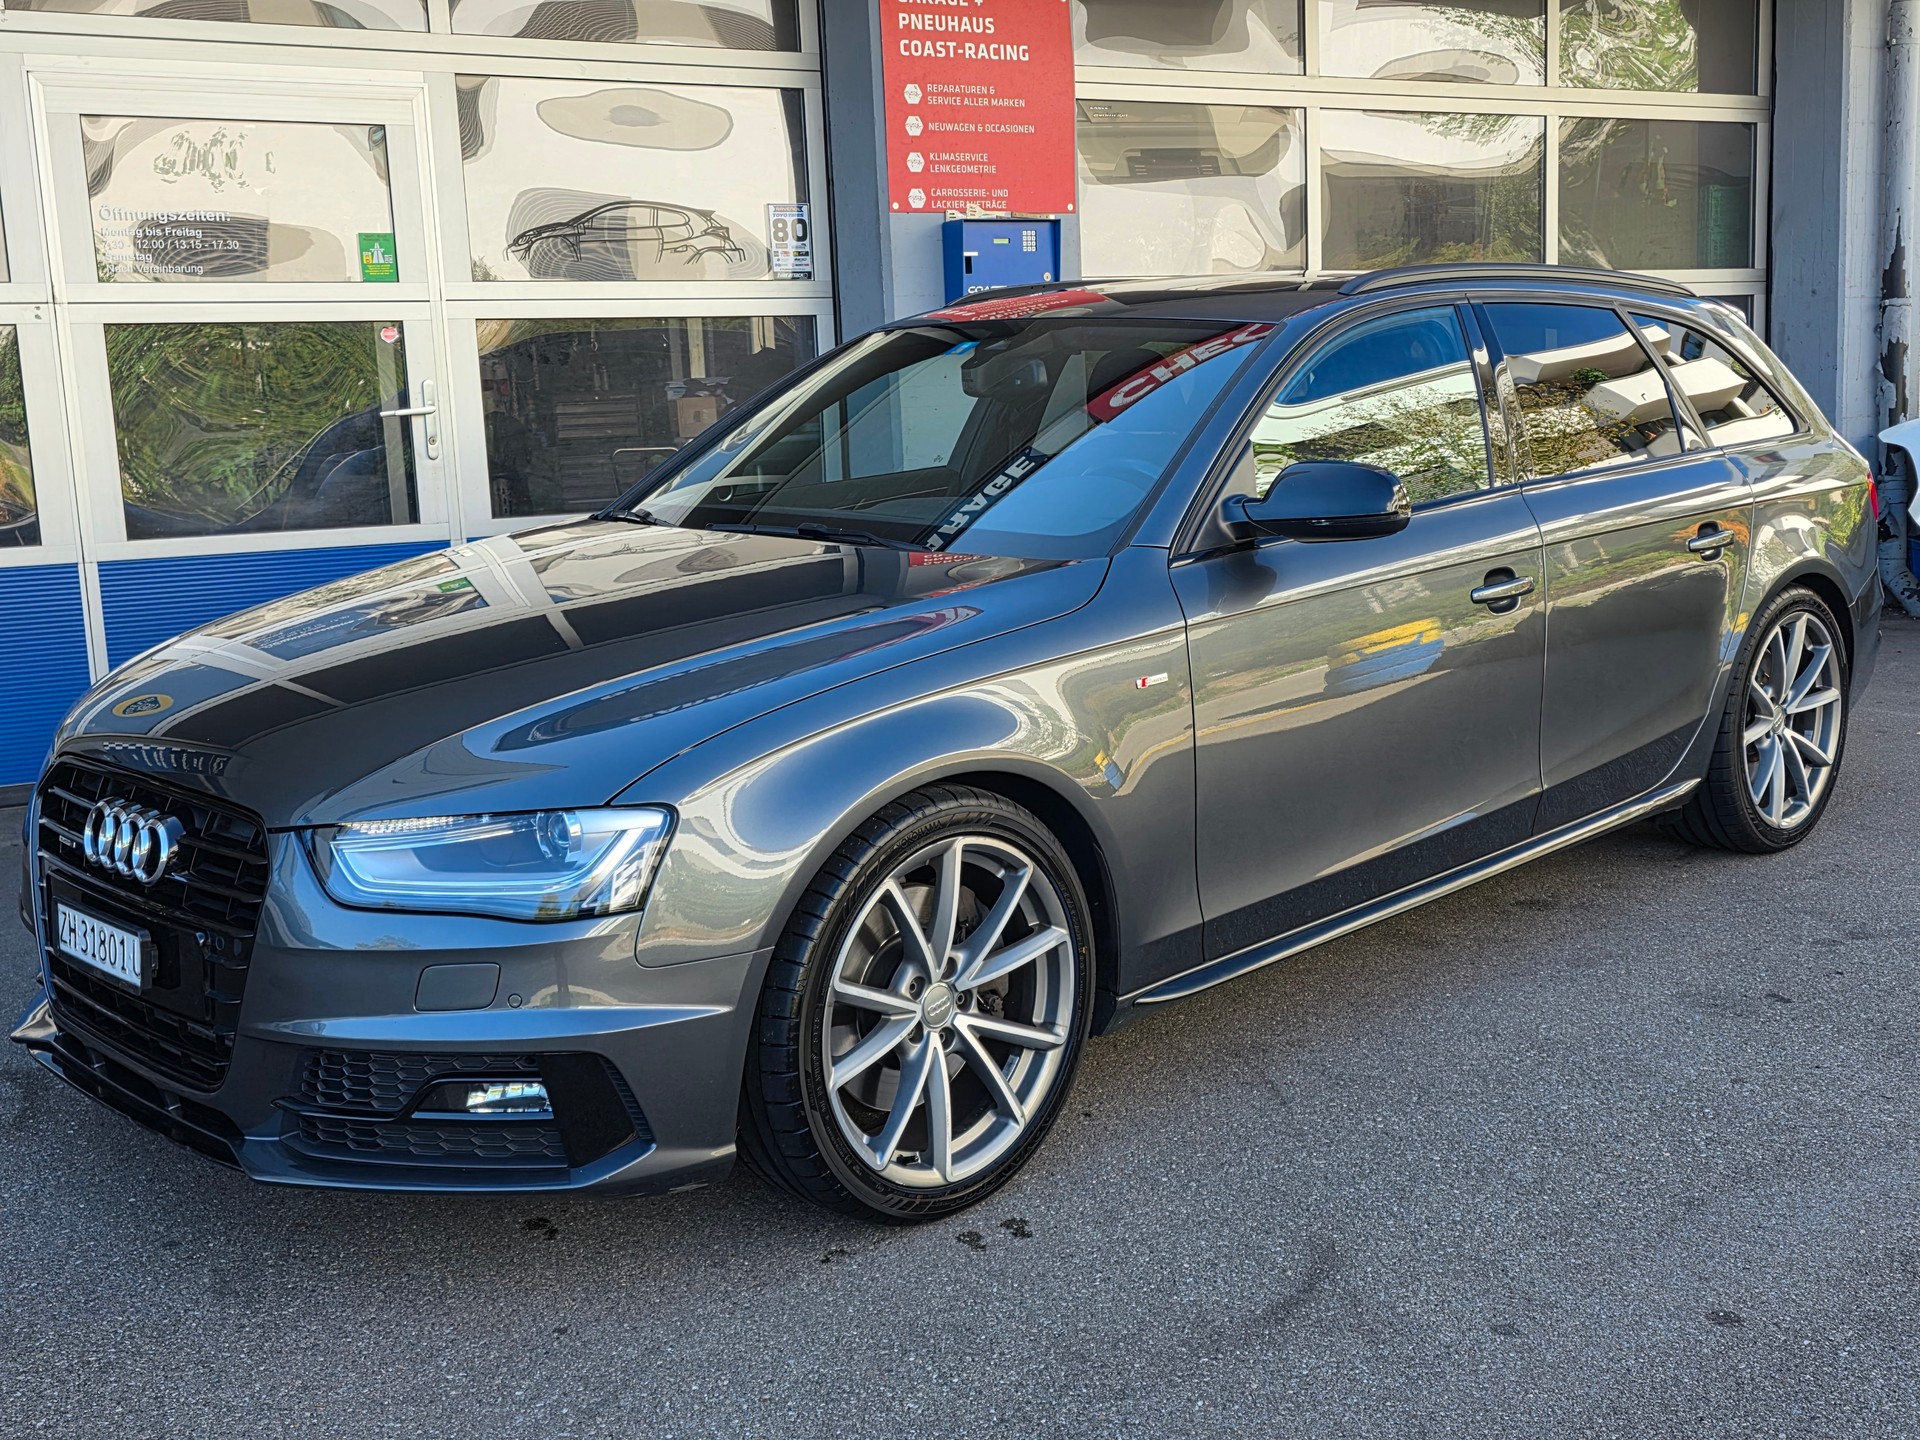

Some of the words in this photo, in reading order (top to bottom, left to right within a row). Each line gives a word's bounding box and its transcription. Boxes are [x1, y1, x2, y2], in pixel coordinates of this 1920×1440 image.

[898, 12, 995, 34] PNEUHAUS
[899, 39, 1029, 61] COAST-RACING
[927, 84, 987, 94] REPARATUREN
[989, 86, 995, 95] &
[927, 96, 961, 105] SERVICE
[963, 97, 989, 106] ALLER
[991, 98, 1025, 107] MARKEN
[928, 122, 975, 132] NEUWAGEN
[977, 123, 983, 132] &
[985, 124, 1035, 133] OCCASIONEN
[929, 152, 988, 162] KLIMASERVICE
[930, 164, 997, 174] LENKGEOMETRIE
[930, 188, 990, 197] CARROSSERIE-
[991, 189, 1009, 198] UND
[99, 205, 231, 224] Öffnungszeiten:
[101, 227, 142, 238] Montag
[145, 227, 162, 237] bis
[165, 227, 202, 238] Freitag
[772, 218, 808, 243] 80
[136, 240, 165, 249] 12.00
[174, 240, 202, 249] 13.15
[211, 240, 240, 250] 17.30
[104, 252, 153, 263] Samstag
[106, 264, 133, 274] Nach
[136, 264, 204, 275] Vereinbarung
[60, 911, 77, 951] ZH
[81, 919, 128, 974] 31801
